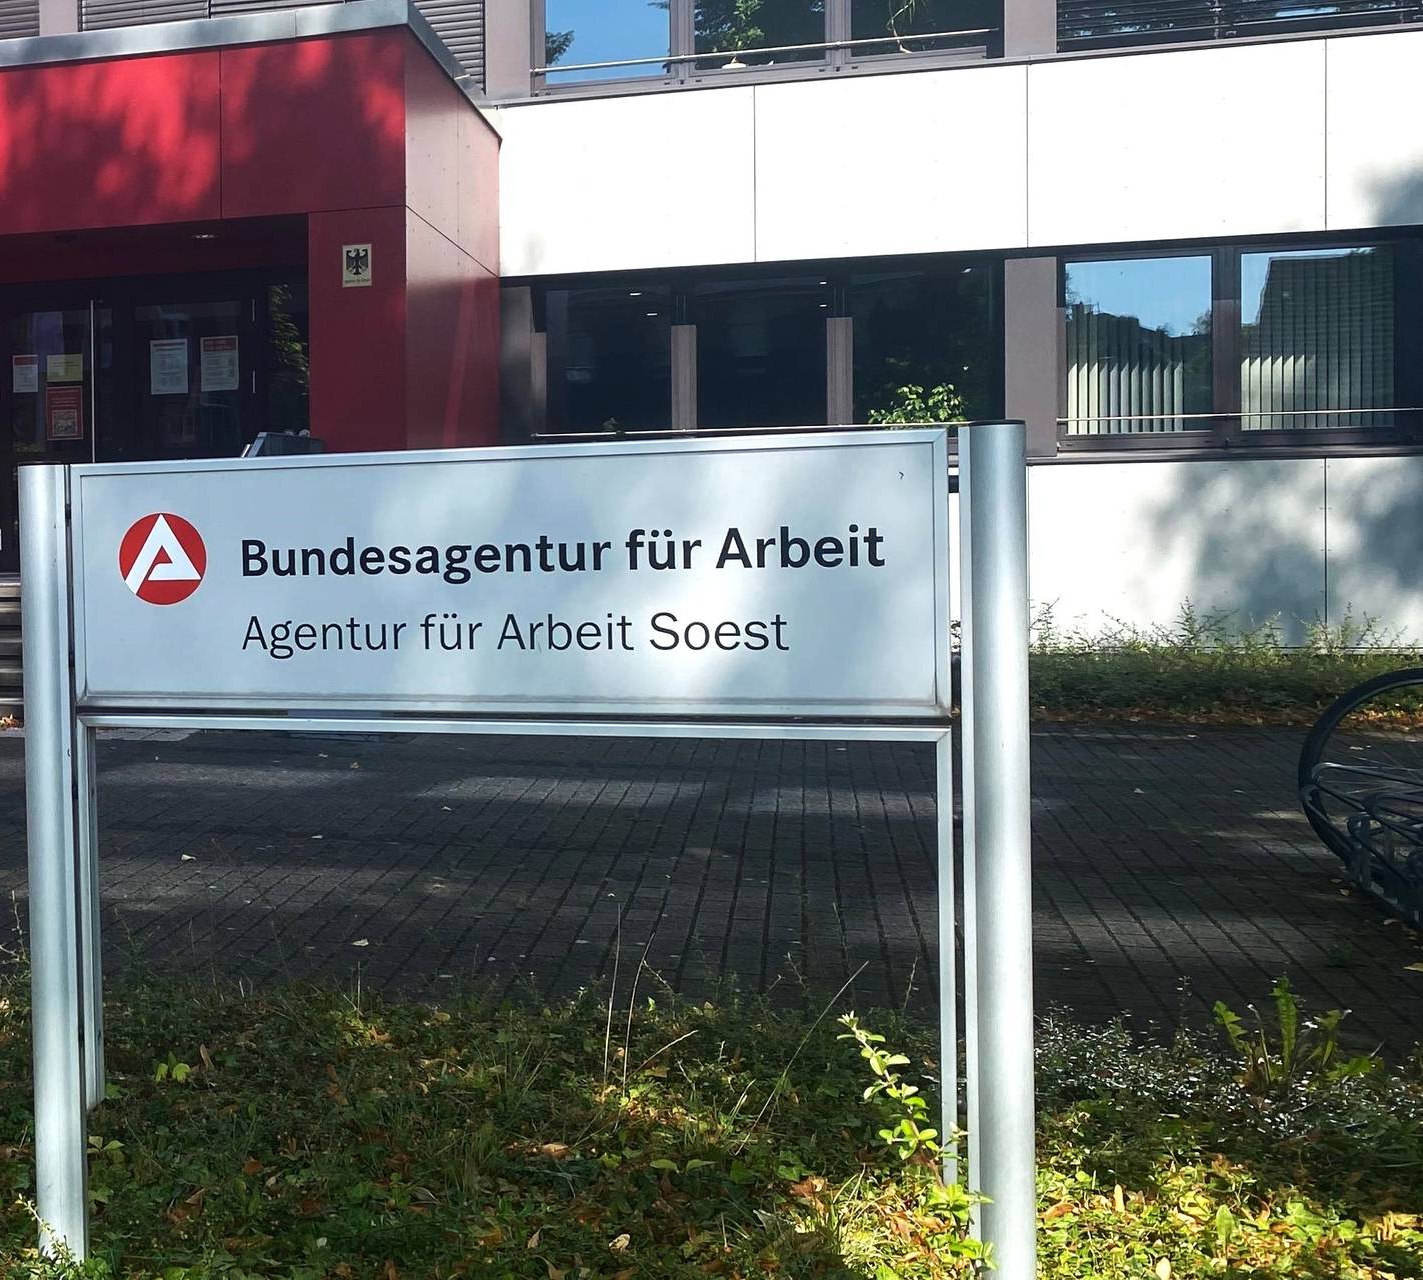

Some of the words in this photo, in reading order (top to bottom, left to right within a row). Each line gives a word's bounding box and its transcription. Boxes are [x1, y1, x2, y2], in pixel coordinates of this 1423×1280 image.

[241, 536, 612, 585] Bundesagentur
[625, 528, 702, 571] für
[715, 524, 886, 569] Arbeit
[241, 615, 407, 660] Agentur
[419, 613, 483, 650] für
[496, 612, 635, 651] Arbeit
[649, 612, 790, 651] Soest
